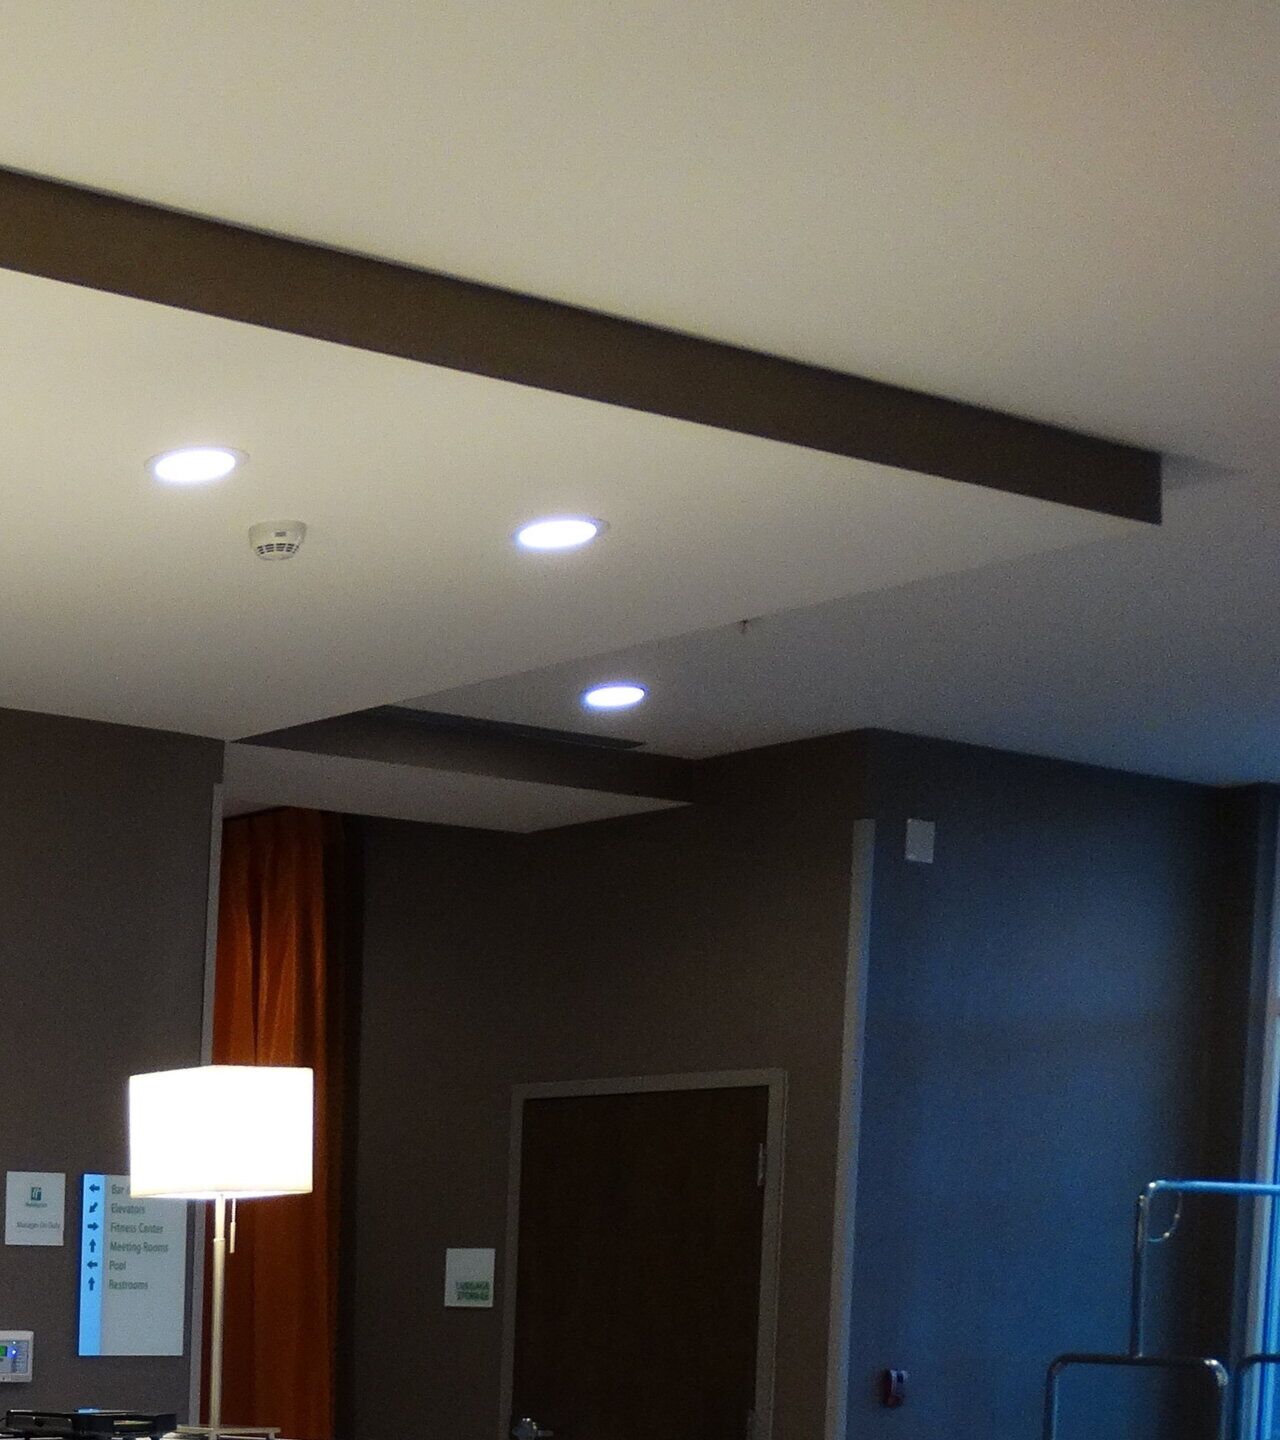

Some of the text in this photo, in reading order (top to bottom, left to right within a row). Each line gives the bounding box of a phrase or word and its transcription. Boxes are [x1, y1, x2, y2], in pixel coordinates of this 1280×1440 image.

[111, 1203, 145, 1215] Elevators
[110, 1222, 164, 1234] Fitness Center
[110, 1241, 169, 1255] Meeting Rooms
[109, 1260, 127, 1271] Pool
[109, 1279, 149, 1291] Restrooms
